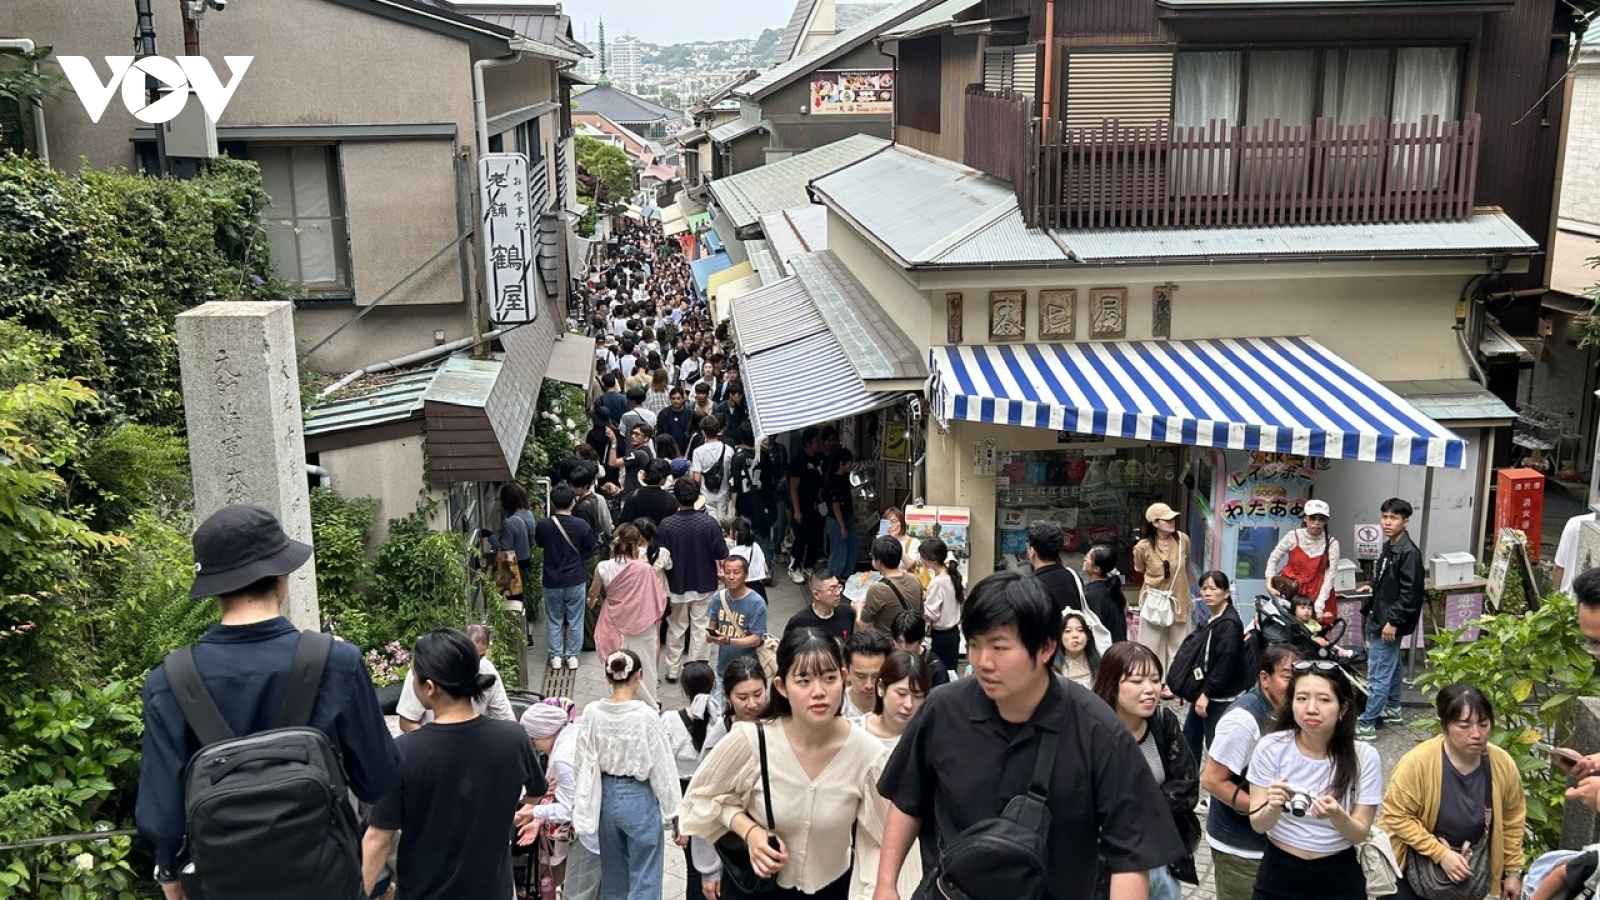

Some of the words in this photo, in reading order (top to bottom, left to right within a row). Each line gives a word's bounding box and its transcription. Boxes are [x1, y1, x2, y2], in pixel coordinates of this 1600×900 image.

[1233, 466, 1311, 487] レインボー
